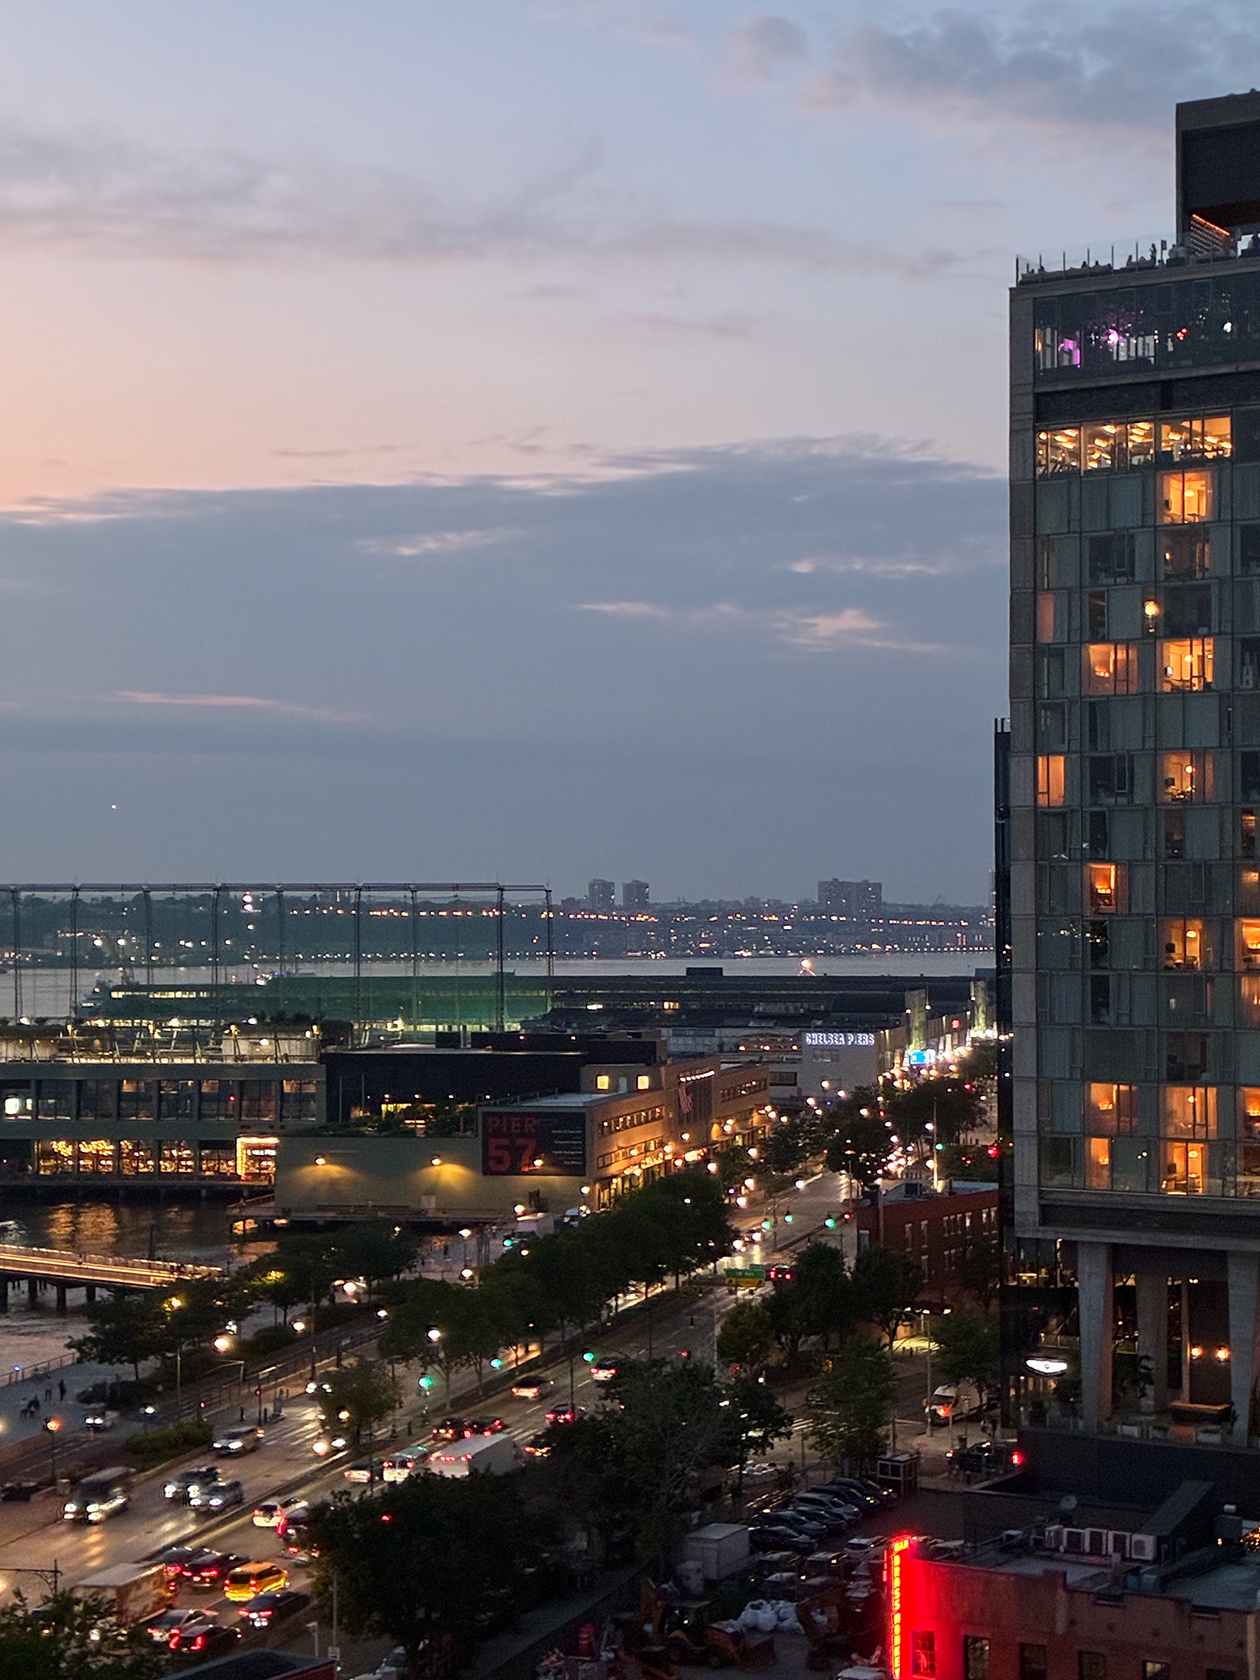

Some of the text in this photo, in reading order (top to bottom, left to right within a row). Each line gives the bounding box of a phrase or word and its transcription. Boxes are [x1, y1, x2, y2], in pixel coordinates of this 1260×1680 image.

[805, 1032, 875, 1046] CHELSEA PIERS
[487, 1116, 537, 1133] PIER
[487, 1137, 538, 1172] 57
[894, 1539, 909, 1552] BAR
